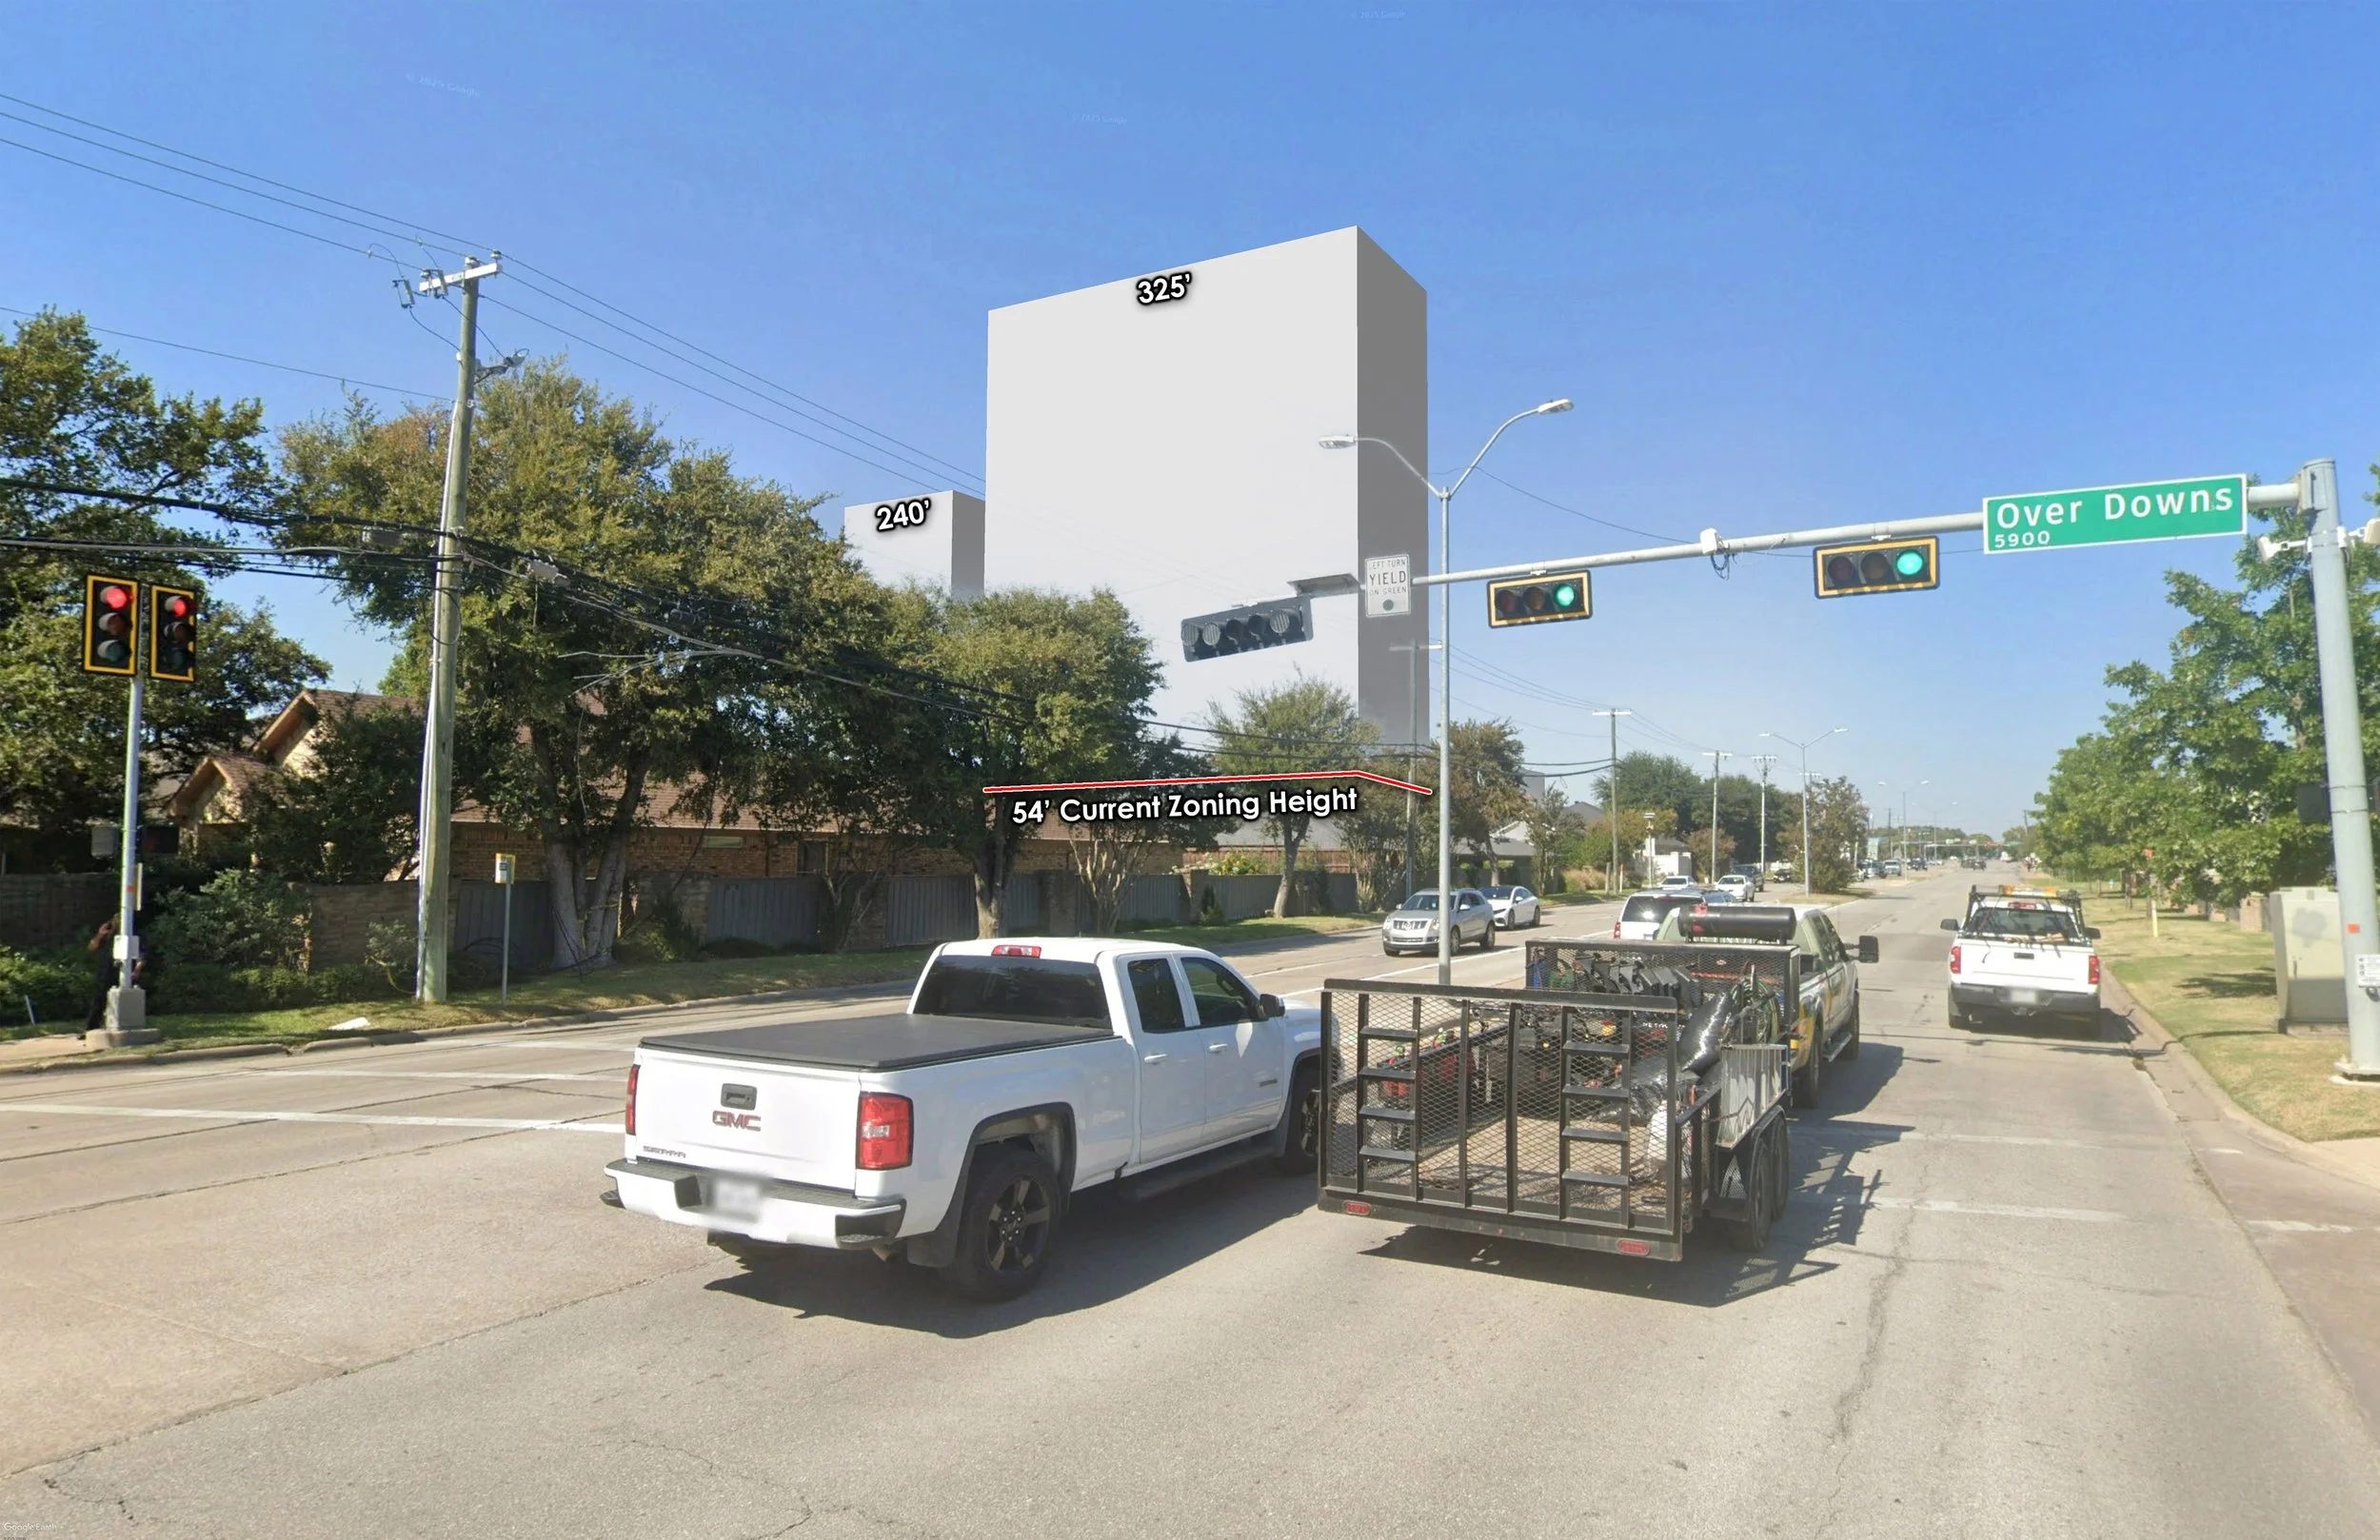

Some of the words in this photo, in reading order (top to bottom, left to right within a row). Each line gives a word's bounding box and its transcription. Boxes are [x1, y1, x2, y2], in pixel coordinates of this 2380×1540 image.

[1996, 500, 2083, 529] Over
[2105, 486, 2233, 521] Downs
[1993, 530, 2051, 549] 5900
[1386, 558, 1406, 568] TURN
[1369, 570, 1406, 585] YIELD
[1382, 586, 1407, 595] GREEN
[712, 1110, 762, 1132] GMC
